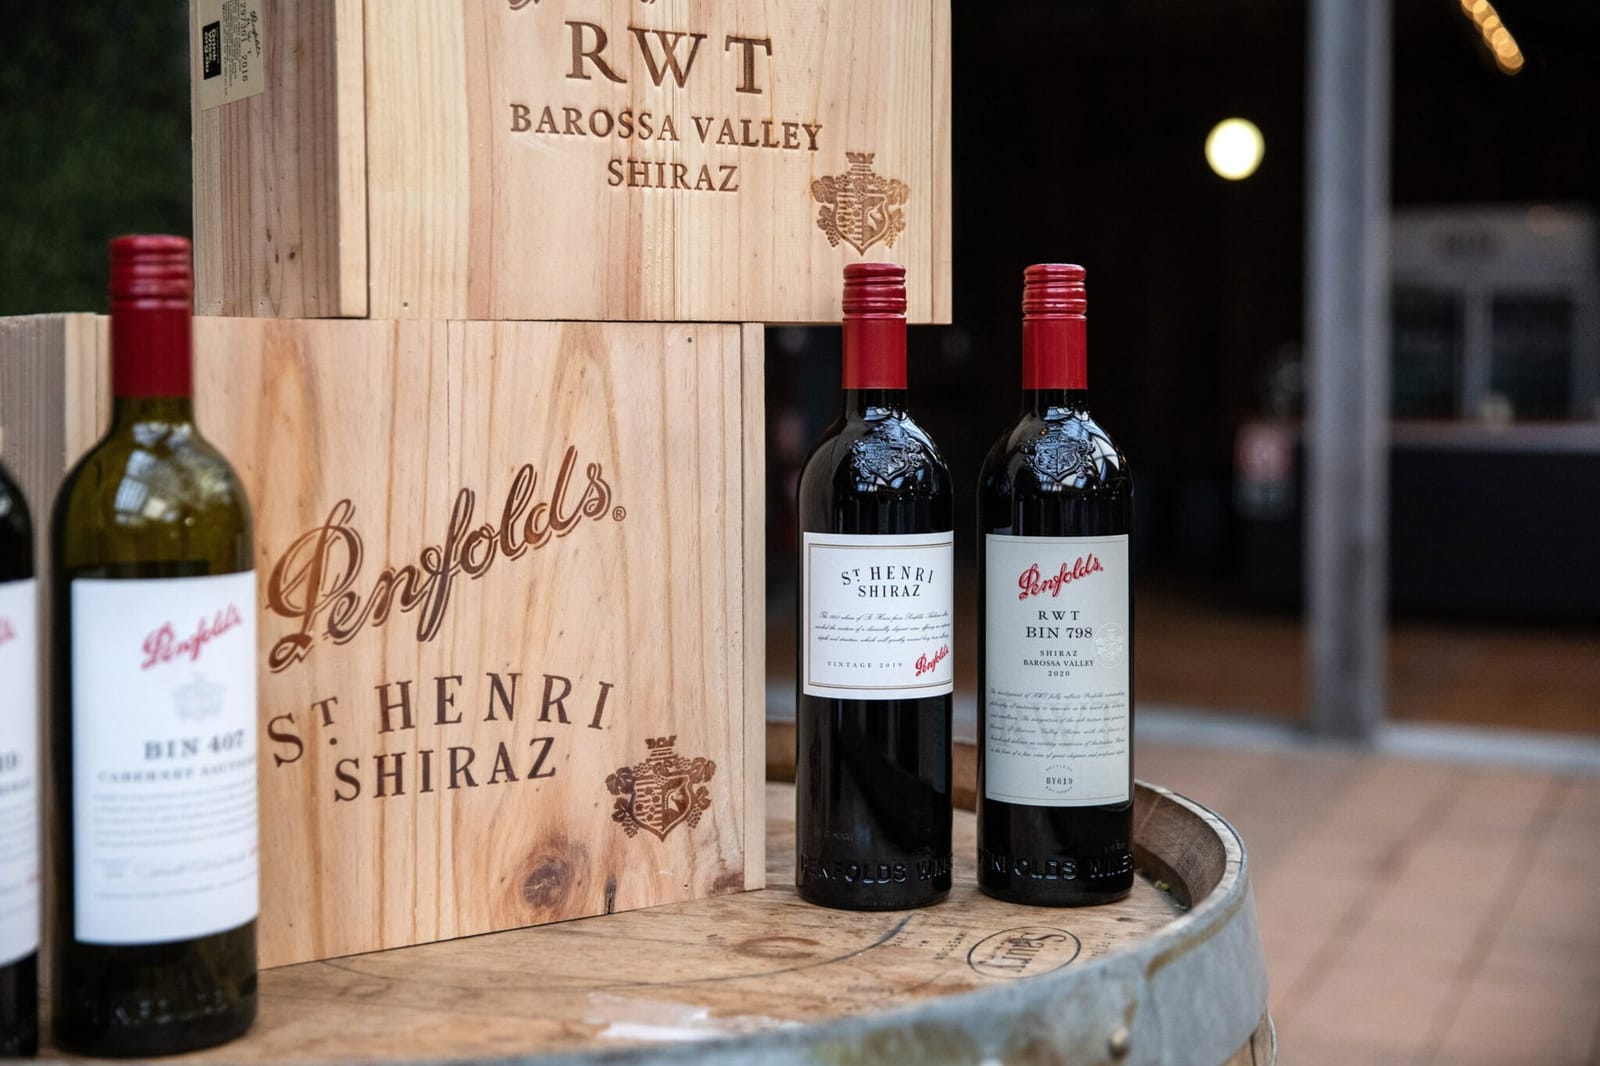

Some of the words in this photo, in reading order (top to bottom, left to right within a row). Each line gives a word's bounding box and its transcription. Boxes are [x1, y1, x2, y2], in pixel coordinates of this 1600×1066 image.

[510, 103, 680, 142] BAROSSA
[691, 116, 824, 151] VALLEY
[607, 158, 739, 192] SHIRAZ
[870, 565, 934, 584] HENRI
[857, 584, 921, 598] SHIRAZ
[1025, 625, 1060, 639] BIN
[1065, 626, 1093, 639] 798
[1039, 649, 1078, 657] SHIRAZ
[827, 660, 873, 669] VINTAGE
[1023, 659, 1061, 667] BAROSSA
[1063, 659, 1095, 667] VALLEY
[374, 672, 615, 734] HENRI
[143, 739, 199, 761] BIN
[206, 730, 244, 752] 407
[334, 737, 556, 802] SHIRAZ
